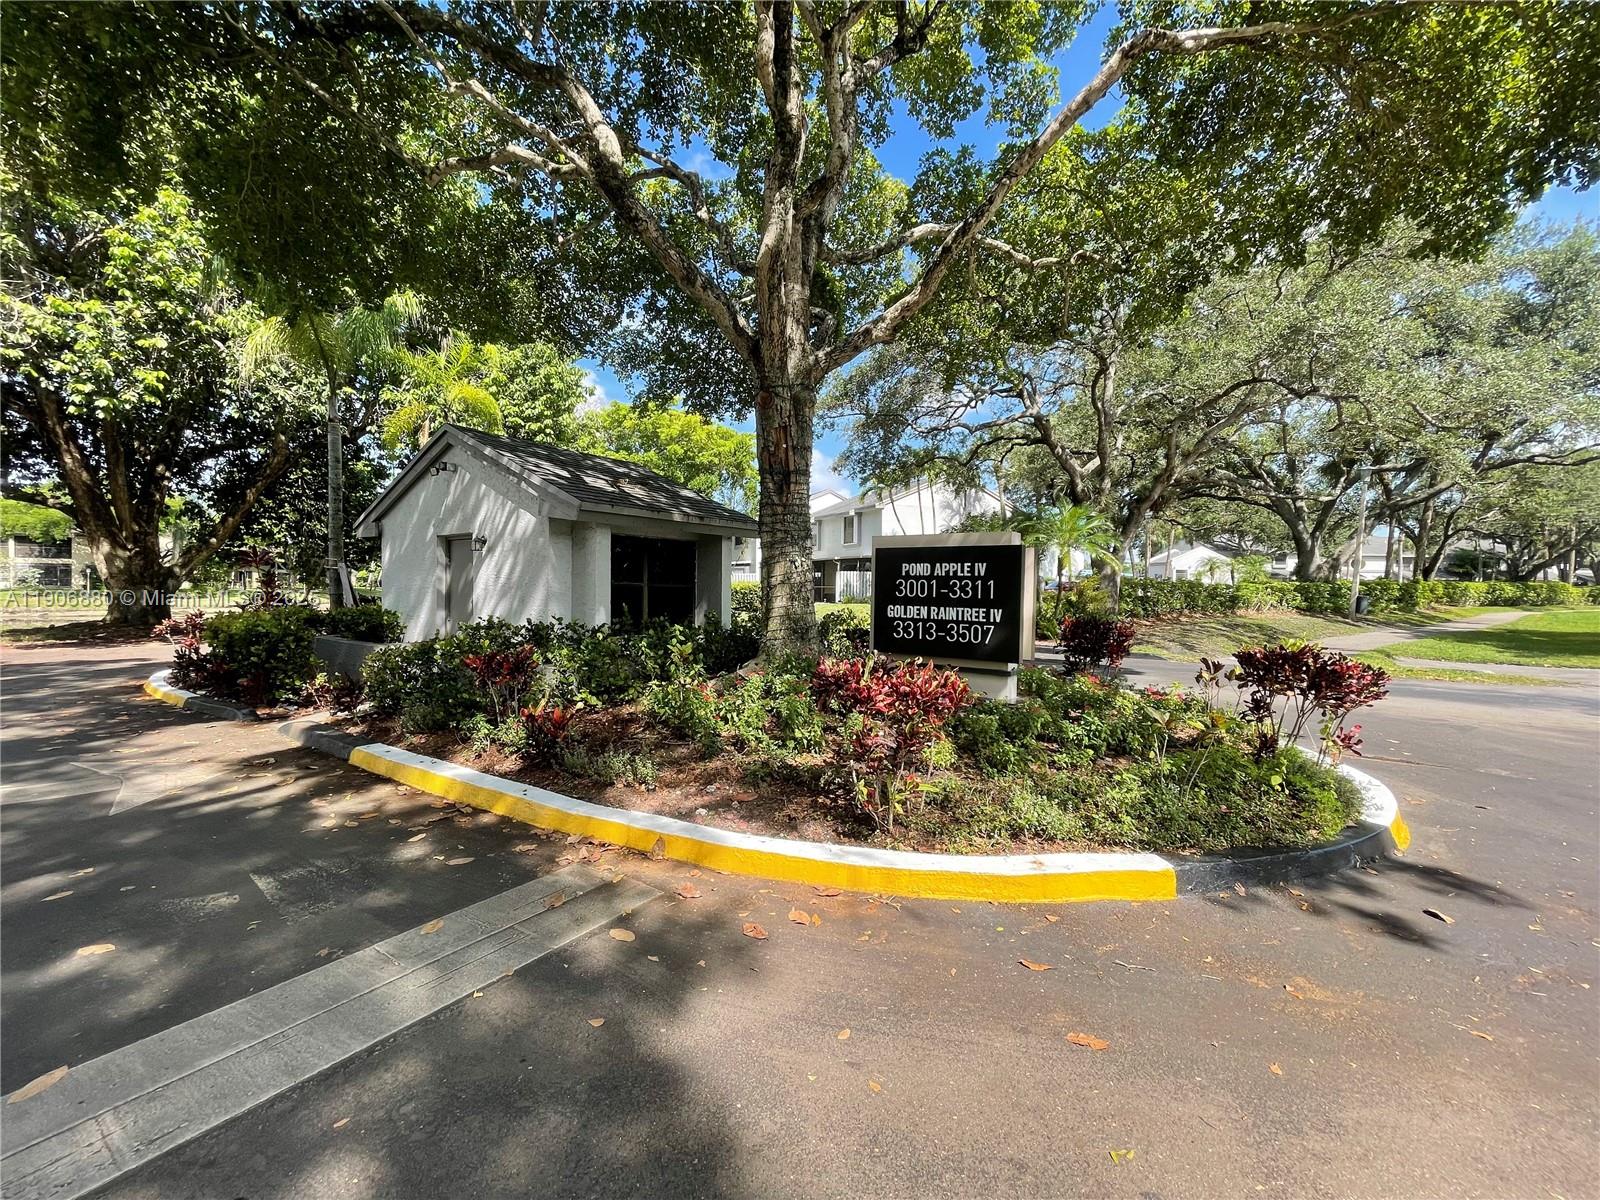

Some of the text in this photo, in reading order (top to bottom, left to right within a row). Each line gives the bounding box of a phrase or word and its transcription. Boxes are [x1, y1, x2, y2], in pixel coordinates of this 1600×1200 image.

[902, 563, 986, 576] POND APPLE IV
[895, 579, 994, 599] 3001-3311
[887, 605, 1002, 623] GOLDEN RAINTREE IV
[893, 620, 994, 644] 3313-3507
